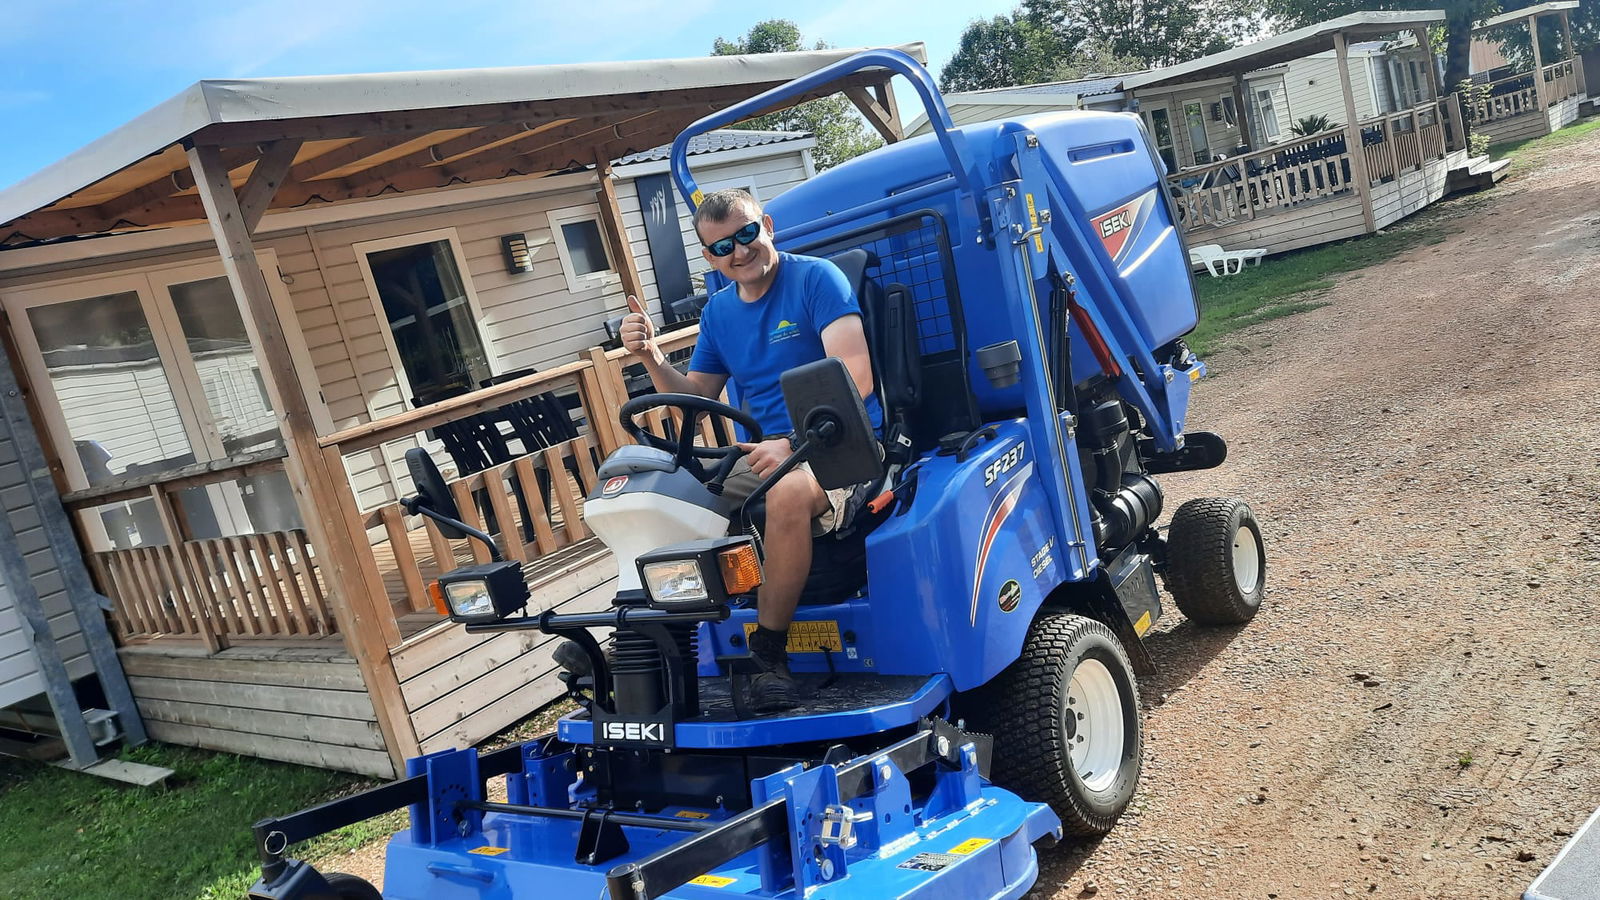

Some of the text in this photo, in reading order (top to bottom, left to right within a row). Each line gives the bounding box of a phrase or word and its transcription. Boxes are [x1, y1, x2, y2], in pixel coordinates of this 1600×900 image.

[1100, 210, 1131, 238] ISEKI
[985, 441, 1025, 487] SF237
[1031, 535, 1055, 567] STAGE V
[602, 722, 665, 742] ISEKI
